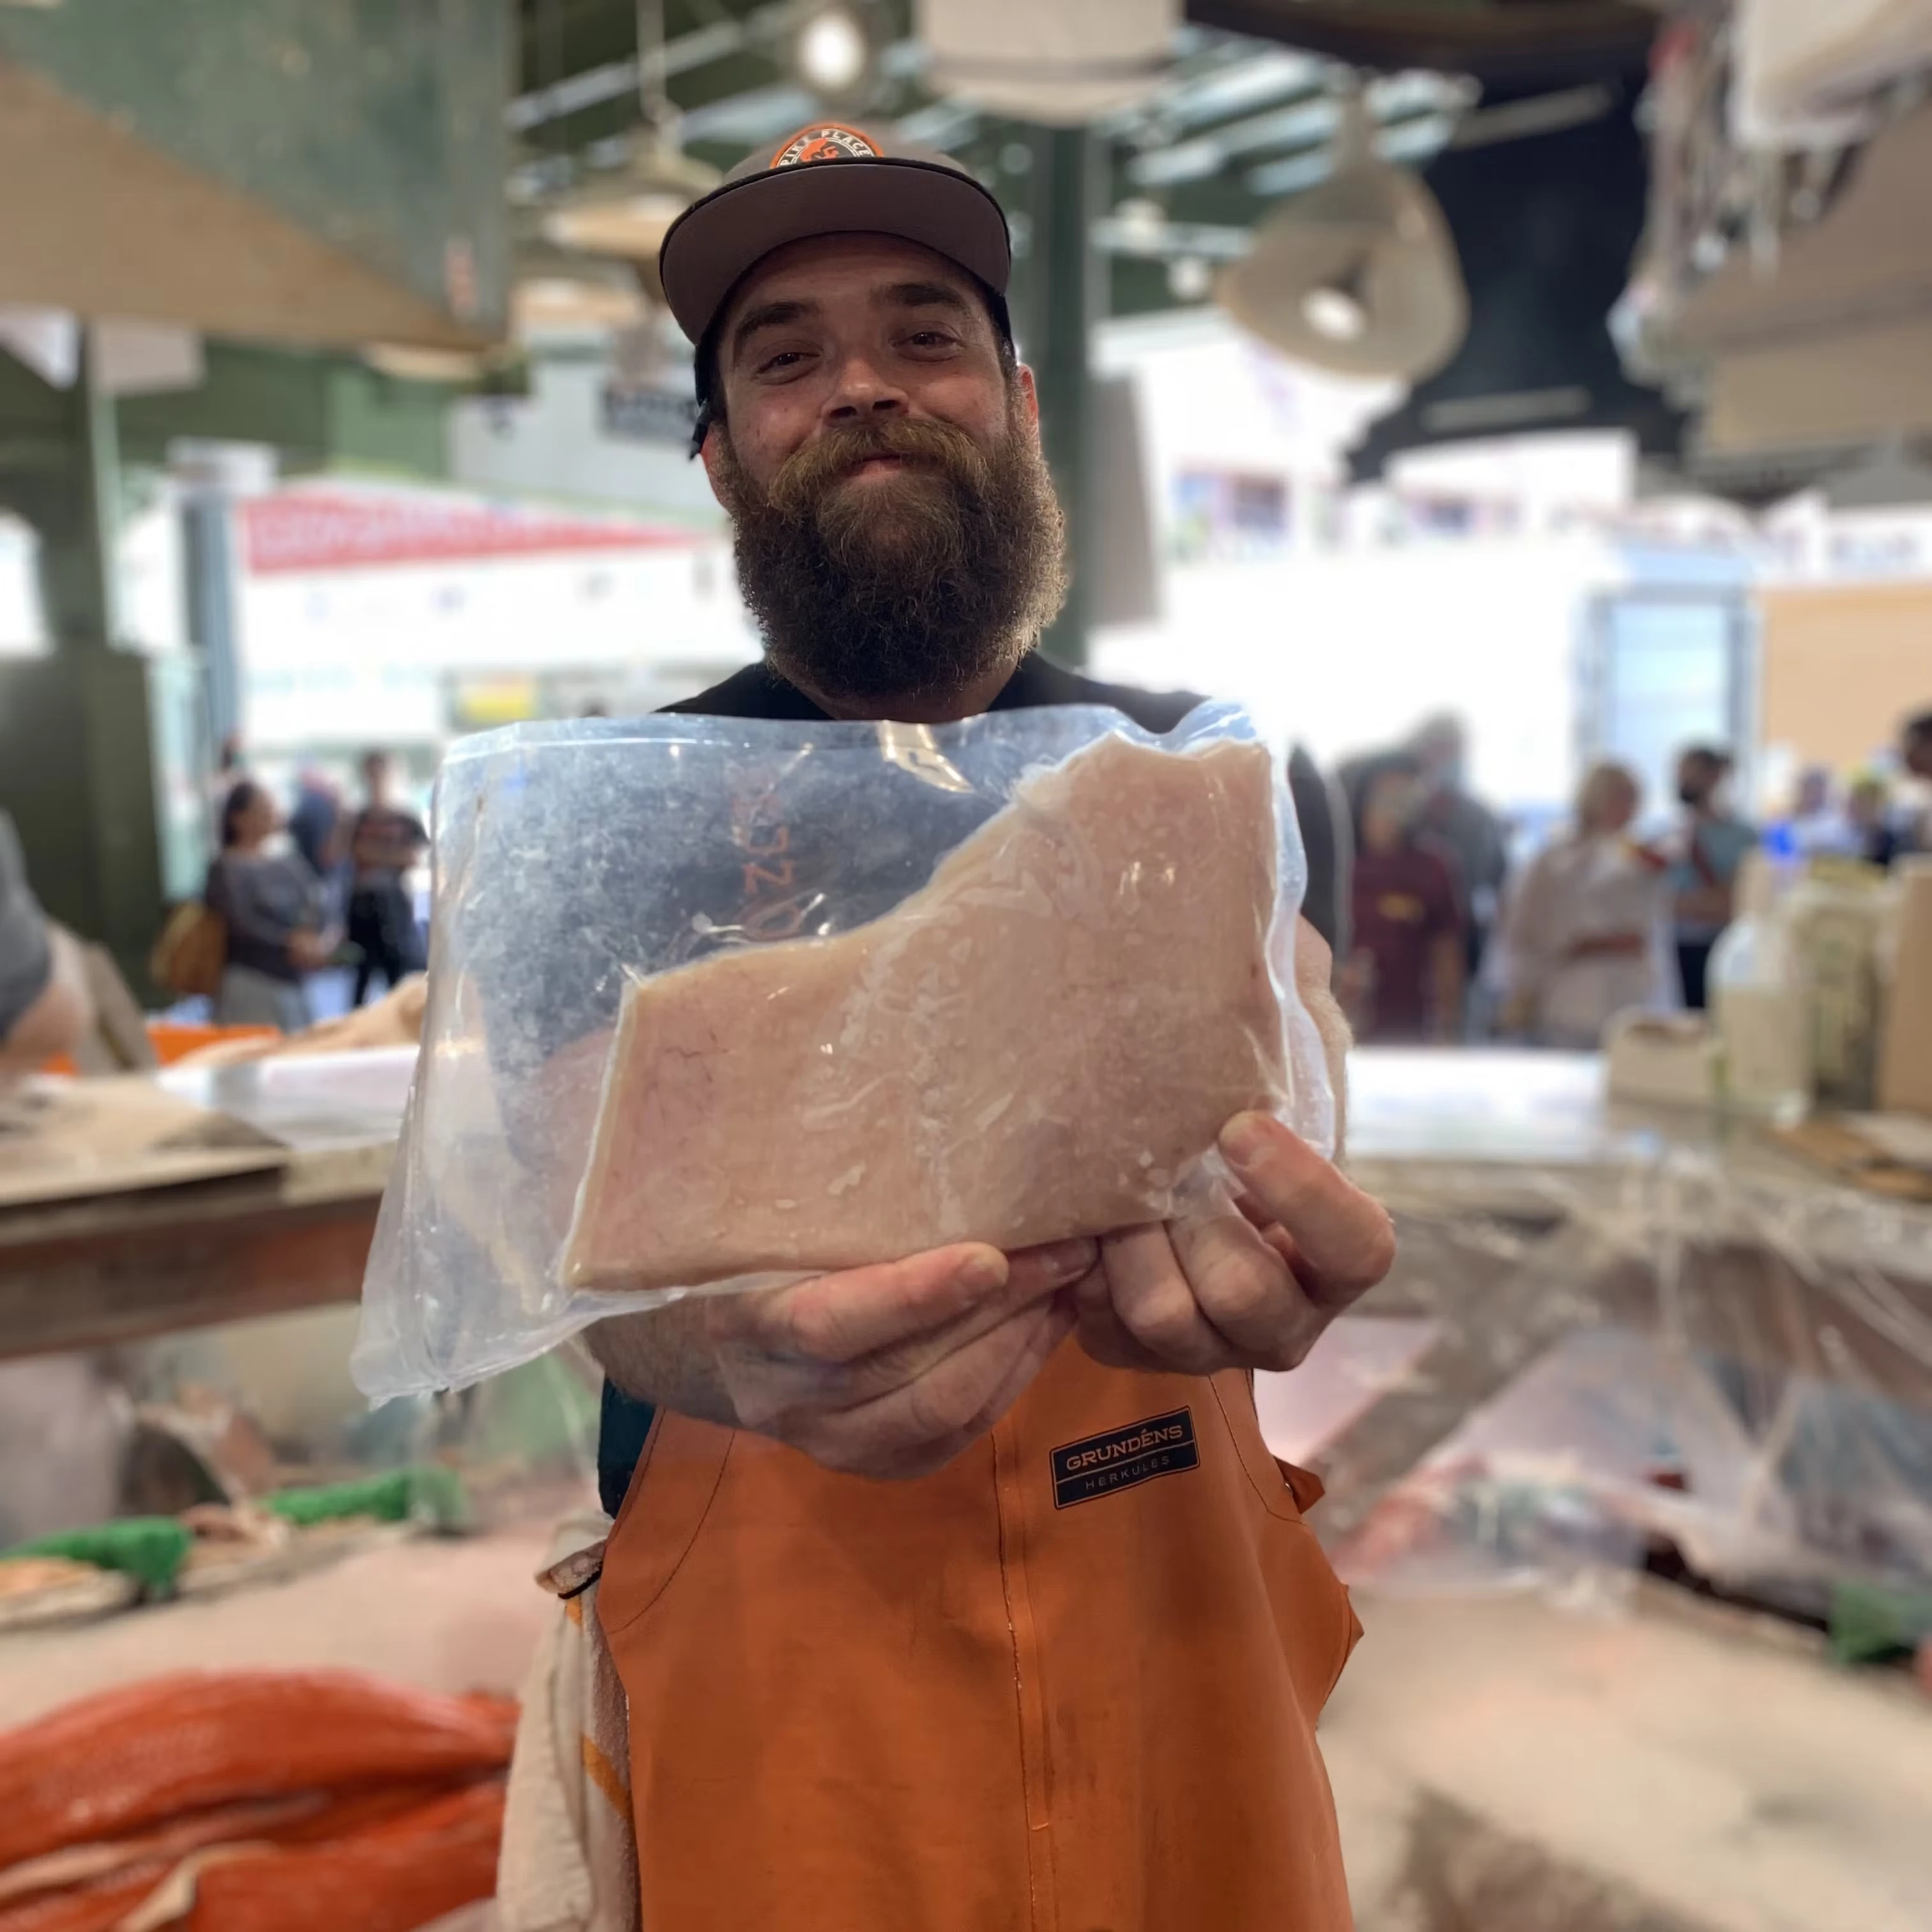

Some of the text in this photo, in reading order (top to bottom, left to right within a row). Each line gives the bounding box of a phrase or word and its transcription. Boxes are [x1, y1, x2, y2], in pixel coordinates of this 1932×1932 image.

[821, 130, 870, 156] PLACE
[1066, 1425, 1183, 1470] GRUNDÉNS
[1085, 1455, 1170, 1490] HERKULES
